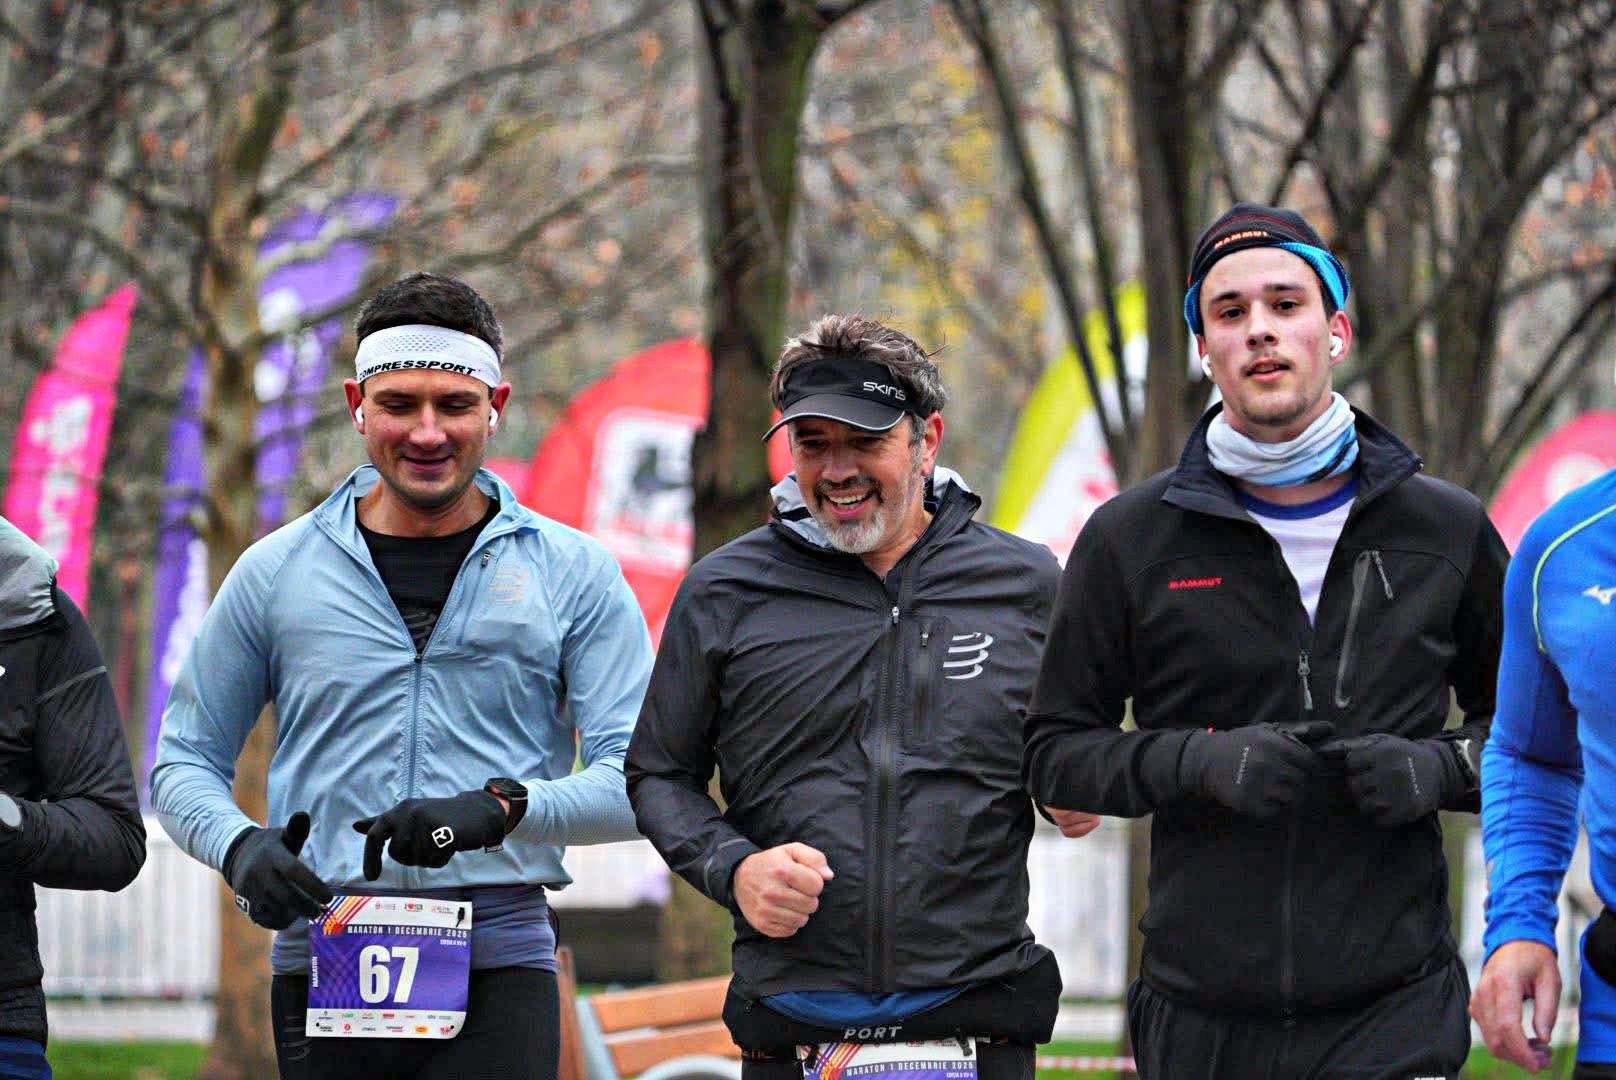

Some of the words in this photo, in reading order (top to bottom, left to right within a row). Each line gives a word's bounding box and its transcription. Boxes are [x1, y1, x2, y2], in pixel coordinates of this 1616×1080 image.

[1168, 577, 1223, 589] MAMMUT
[347, 925, 383, 934] MARATON
[395, 926, 442, 936] DECEMBRIE
[359, 945, 420, 1004] 67
[843, 1026, 902, 1040] PORT
[846, 1062, 885, 1077] MARATON
[898, 1061, 947, 1071] DECEMBRIE
